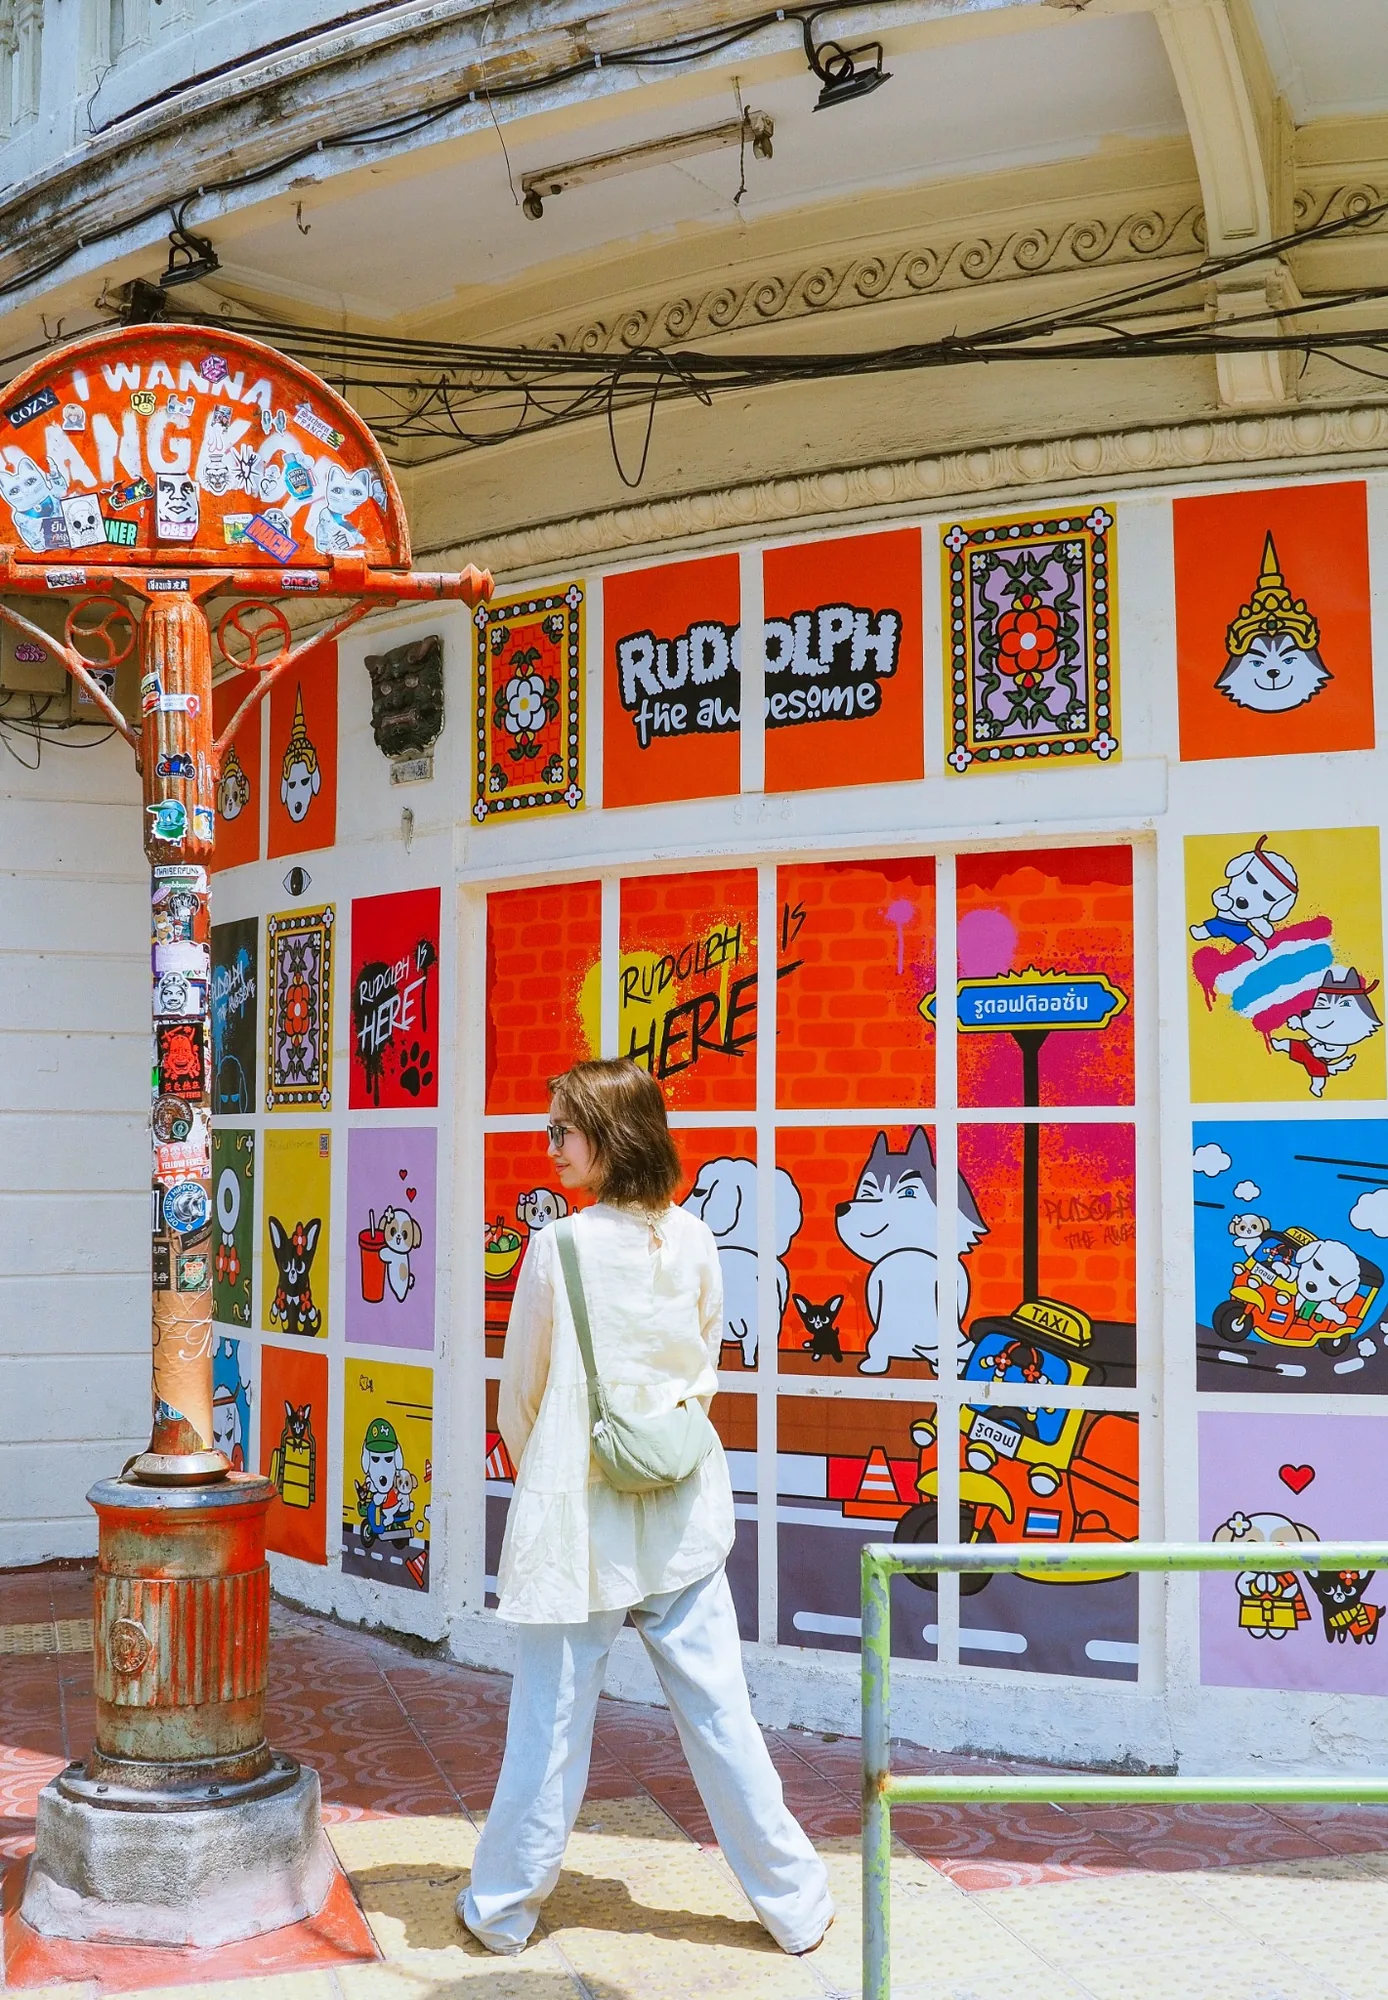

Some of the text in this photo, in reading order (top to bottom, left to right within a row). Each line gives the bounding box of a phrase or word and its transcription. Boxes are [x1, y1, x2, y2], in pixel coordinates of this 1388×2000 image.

[72, 369, 90, 401] I
[101, 359, 273, 409] WANNA
[10, 391, 54, 425] COZY
[297, 415, 328, 441] TRANCE
[161, 522, 196, 537] OBEY
[247, 516, 294, 559] MACH
[619, 606, 898, 704] RUDOLPH
[635, 682, 876, 745] the awesome
[618, 900, 807, 1009] RUDOLPH IS
[358, 942, 428, 1006] RUDOLPH IS
[357, 976, 427, 1056] HERE
[624, 960, 805, 1080] HERE
[973, 987, 1089, 1019] รูดอฟดิออซั่ม
[172, 1184, 199, 1196] HIPPOS
[1064, 1230, 1098, 1250] THE
[1032, 1306, 1071, 1335] TAXI
[975, 1422, 1017, 1449] รูดอฟ
